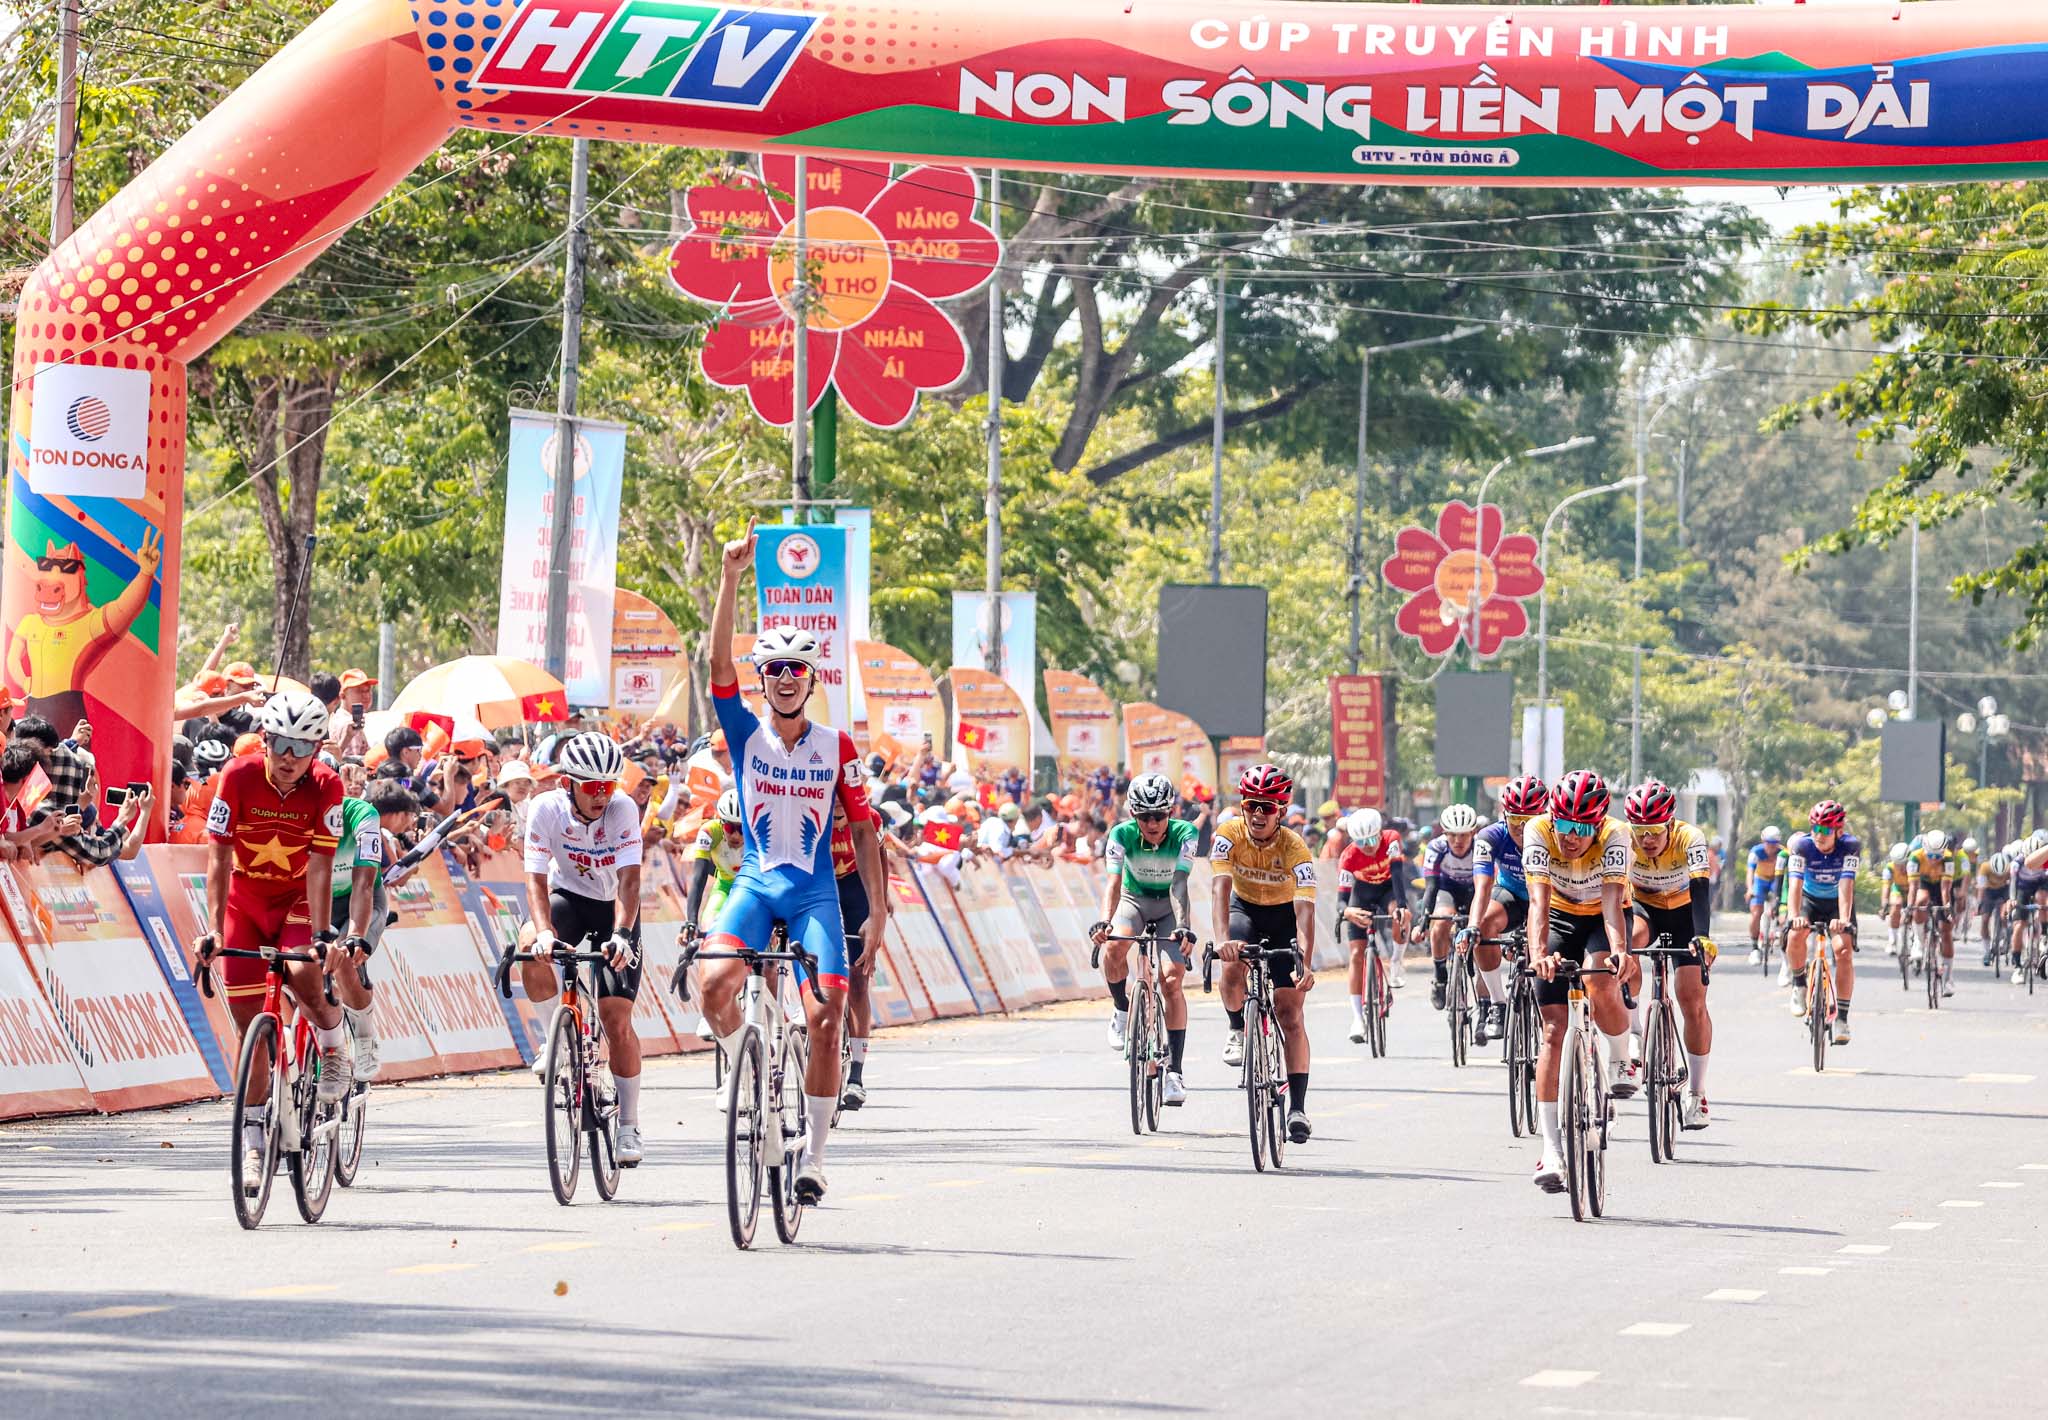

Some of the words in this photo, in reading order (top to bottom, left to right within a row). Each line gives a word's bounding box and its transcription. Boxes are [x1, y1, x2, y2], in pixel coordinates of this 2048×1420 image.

[1190, 15, 1310, 52] CÚP
[1580, 20, 1728, 57] HÌNH
[496, 8, 798, 88] HTV
[958, 65, 1127, 124] NON
[1162, 64, 1373, 141] SÔNG
[1406, 61, 1560, 135] LIỀN
[1594, 70, 1768, 145] MỘT
[1806, 62, 1930, 140] DẢI
[1361, 151, 1394, 162] HTV
[1410, 149, 1444, 163] TÔN
[807, 168, 842, 195] TUỆ
[896, 206, 960, 229] NĂNG
[836, 276, 877, 294] THƠ
[864, 326, 924, 348] NHÂN
[882, 356, 905, 378] ÁI
[33, 448, 68, 466] TON
[72, 450, 128, 470] DONG
[131, 455, 145, 470] A
[765, 583, 801, 605] TOÀN
[805, 585, 833, 605] DÂN
[794, 613, 837, 634] LUYỆN
[751, 754, 769, 775] 620
[790, 785, 825, 799] LONG
[210, 803, 228, 824] 23
[371, 838, 379, 854] 6
[1525, 850, 1549, 867] 153
[74, 998, 130, 1064] TON
[108, 991, 179, 1061] DONG
[160, 991, 195, 1054] A
